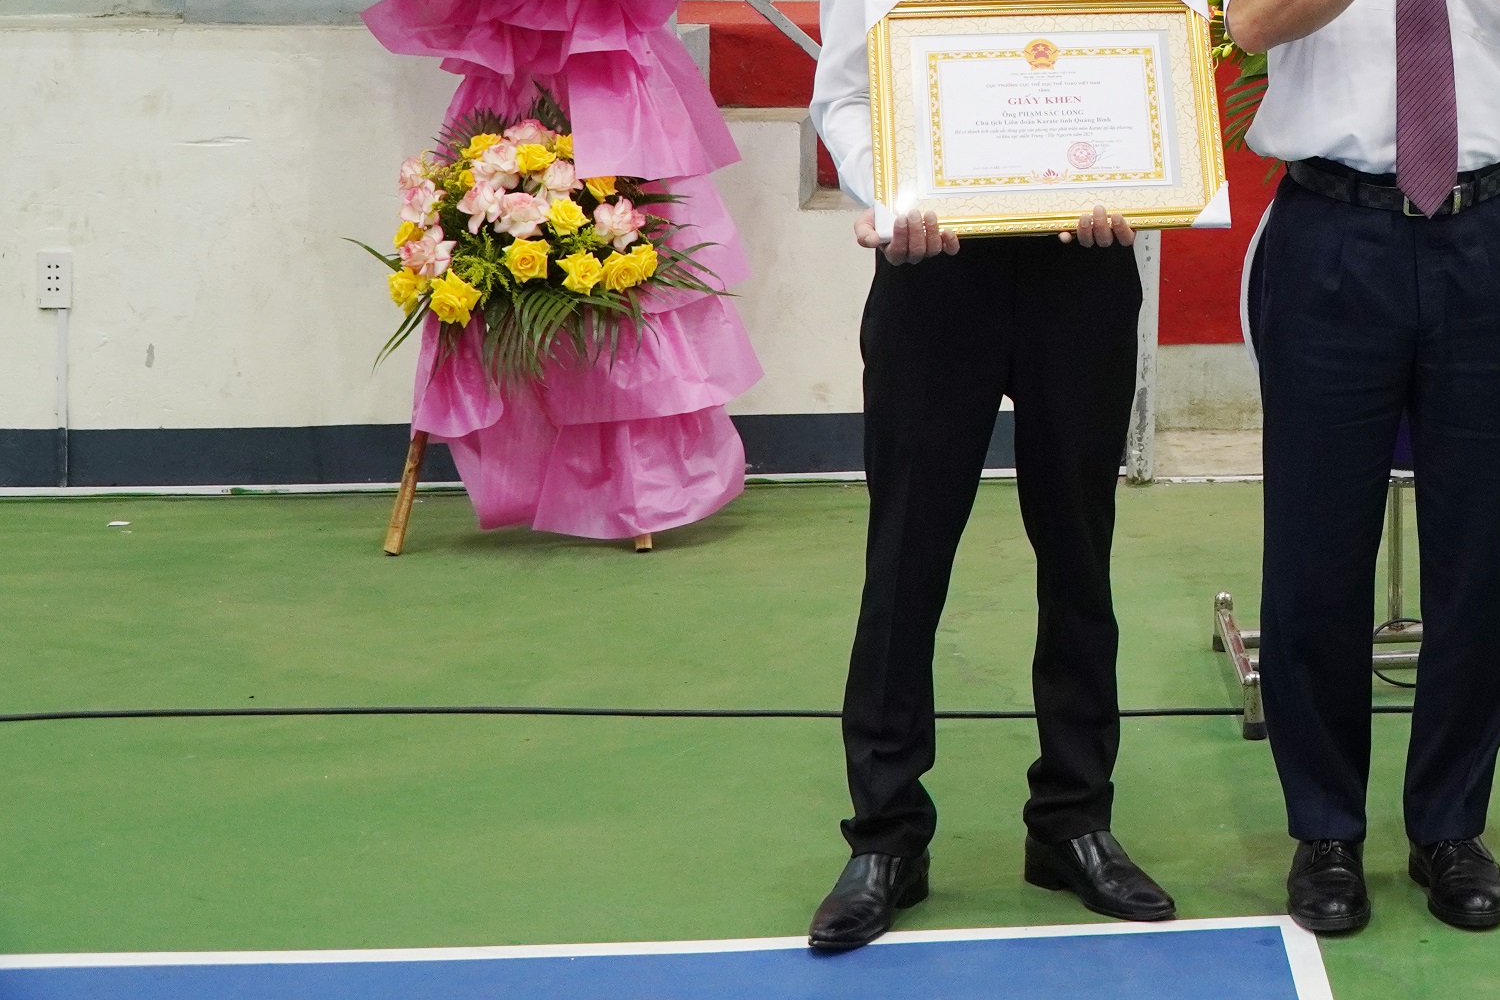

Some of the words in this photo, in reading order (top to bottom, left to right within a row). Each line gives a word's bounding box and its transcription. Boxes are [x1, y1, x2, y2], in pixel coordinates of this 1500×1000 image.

[1008, 93, 1041, 105] GIẤY
[1045, 96, 1082, 104] KHEN
[1002, 110, 1017, 118] Ông
